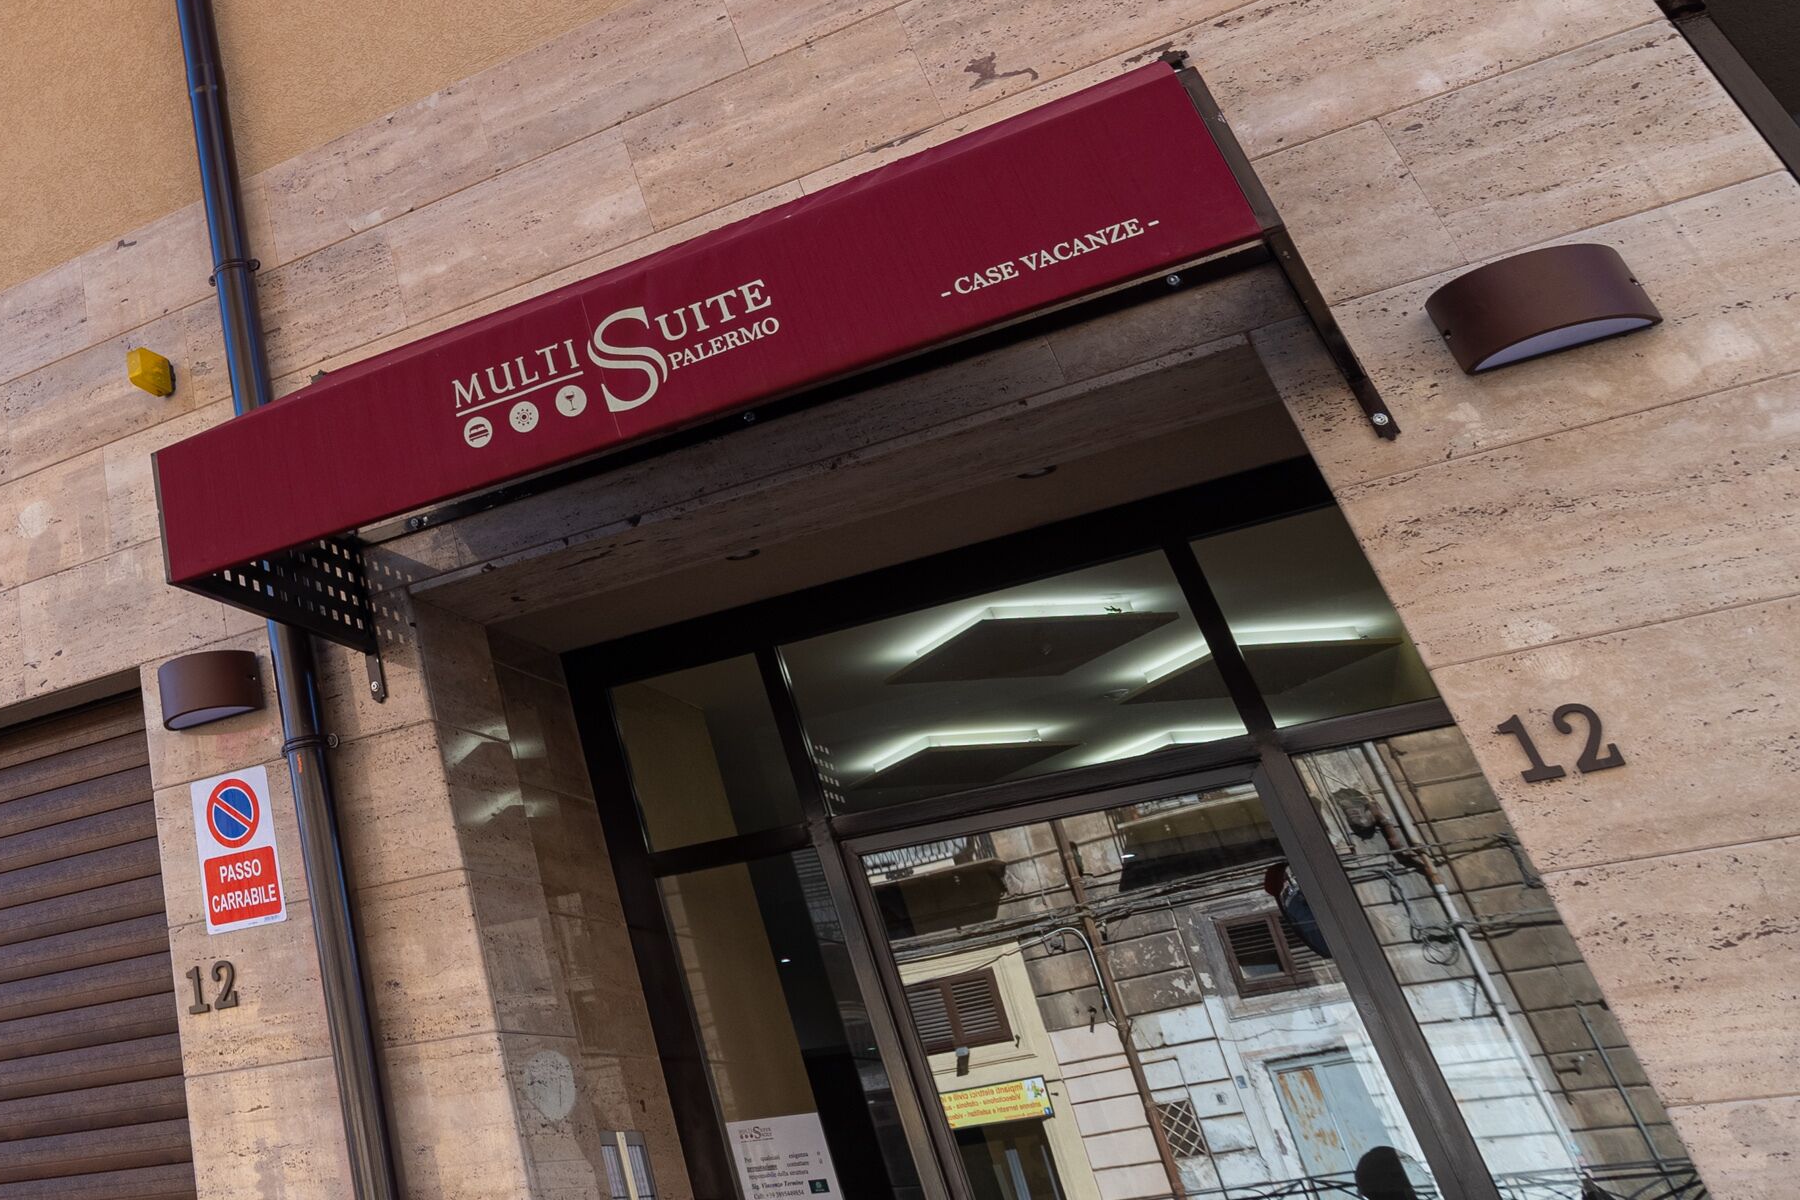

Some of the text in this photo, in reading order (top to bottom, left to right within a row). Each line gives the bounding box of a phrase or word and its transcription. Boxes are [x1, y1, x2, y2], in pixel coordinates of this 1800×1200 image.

[954, 261, 1019, 295] CASE
[1019, 218, 1144, 271] VACANZE
[667, 317, 780, 370] PALERMO
[1497, 703, 1626, 783] 12
[219, 858, 262, 883] PASSO
[212, 884, 277, 913] CARRABILE
[186, 960, 239, 1015] 12
